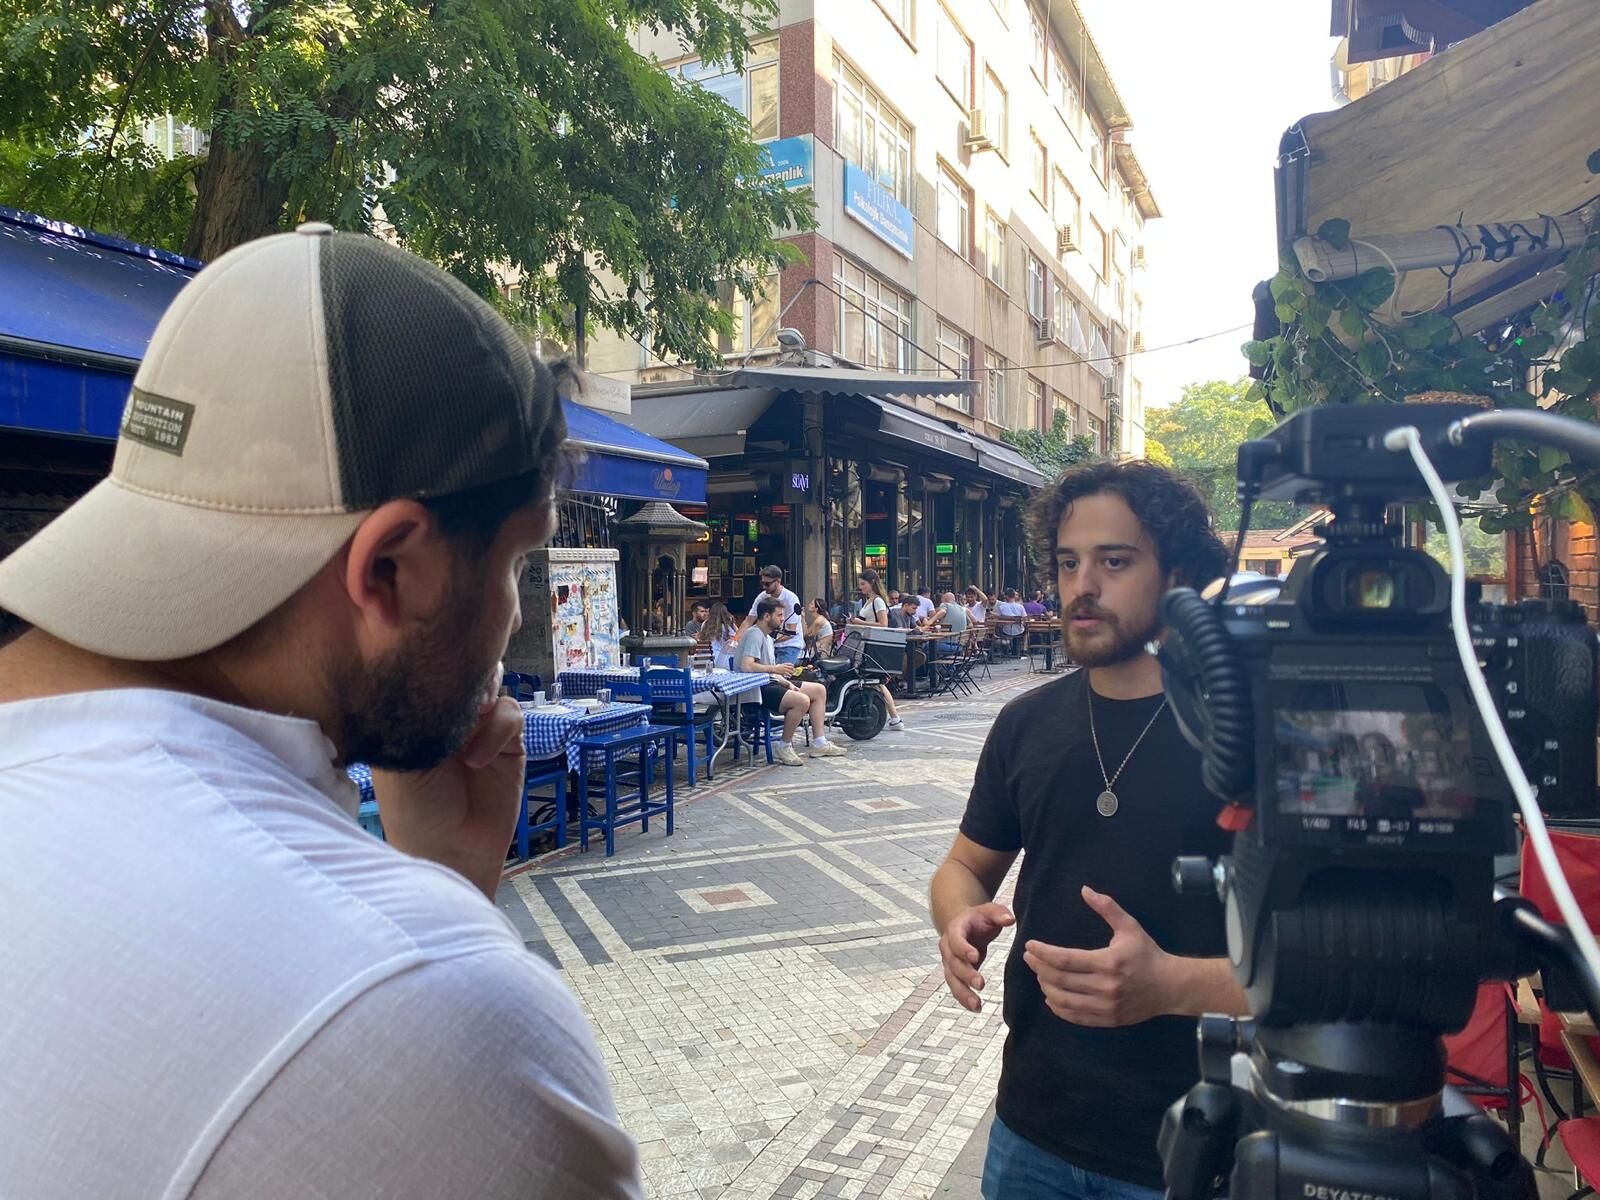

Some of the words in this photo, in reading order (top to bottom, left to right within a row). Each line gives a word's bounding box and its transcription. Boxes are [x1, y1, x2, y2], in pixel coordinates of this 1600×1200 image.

[1507, 709, 1526, 719] DISP
[1544, 740, 1558, 750] ISO
[1543, 775, 1557, 786] C4
[1304, 1183, 1399, 1200] DEYATE
